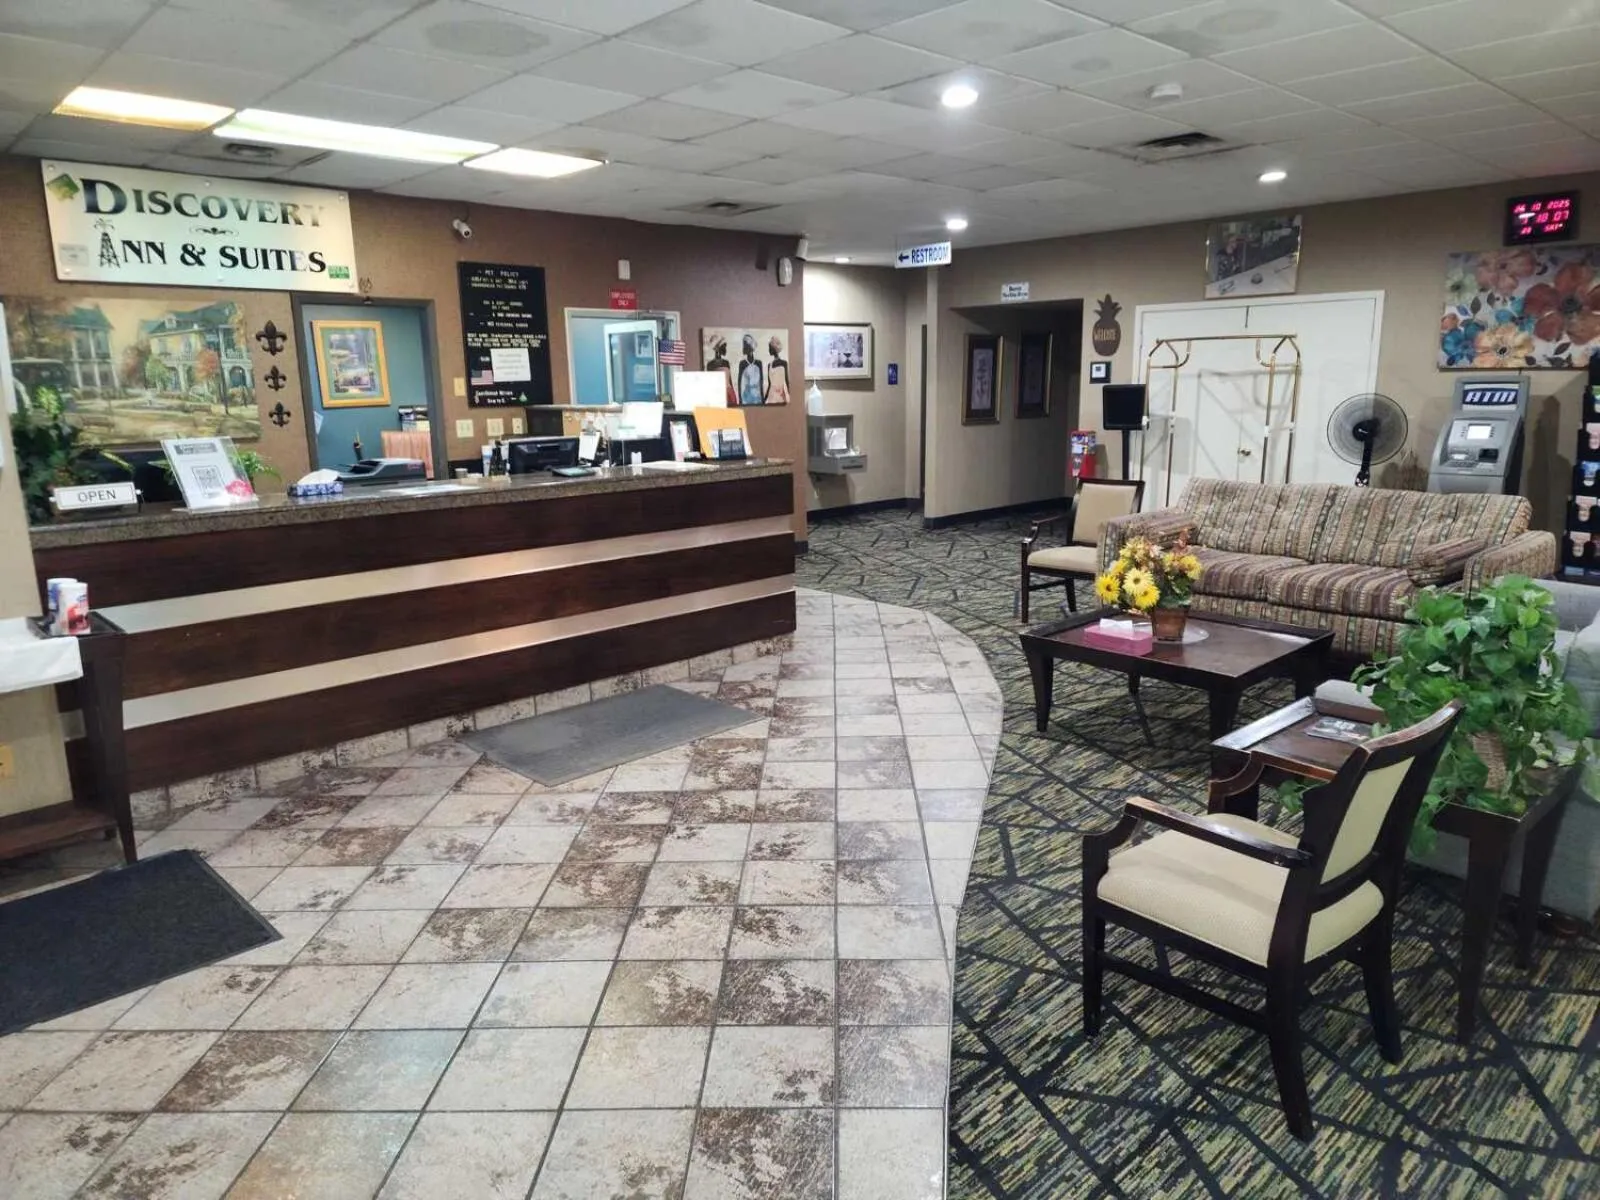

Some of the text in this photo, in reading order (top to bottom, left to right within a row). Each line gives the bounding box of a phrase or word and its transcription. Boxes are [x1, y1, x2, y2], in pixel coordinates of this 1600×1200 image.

[80, 178, 325, 227] DISCOVERY
[180, 243, 207, 267] &
[220, 245, 327, 274] SUITES
[911, 246, 949, 263] RESTROOM
[1466, 391, 1516, 402] ATM
[78, 488, 117, 502] OPEN
